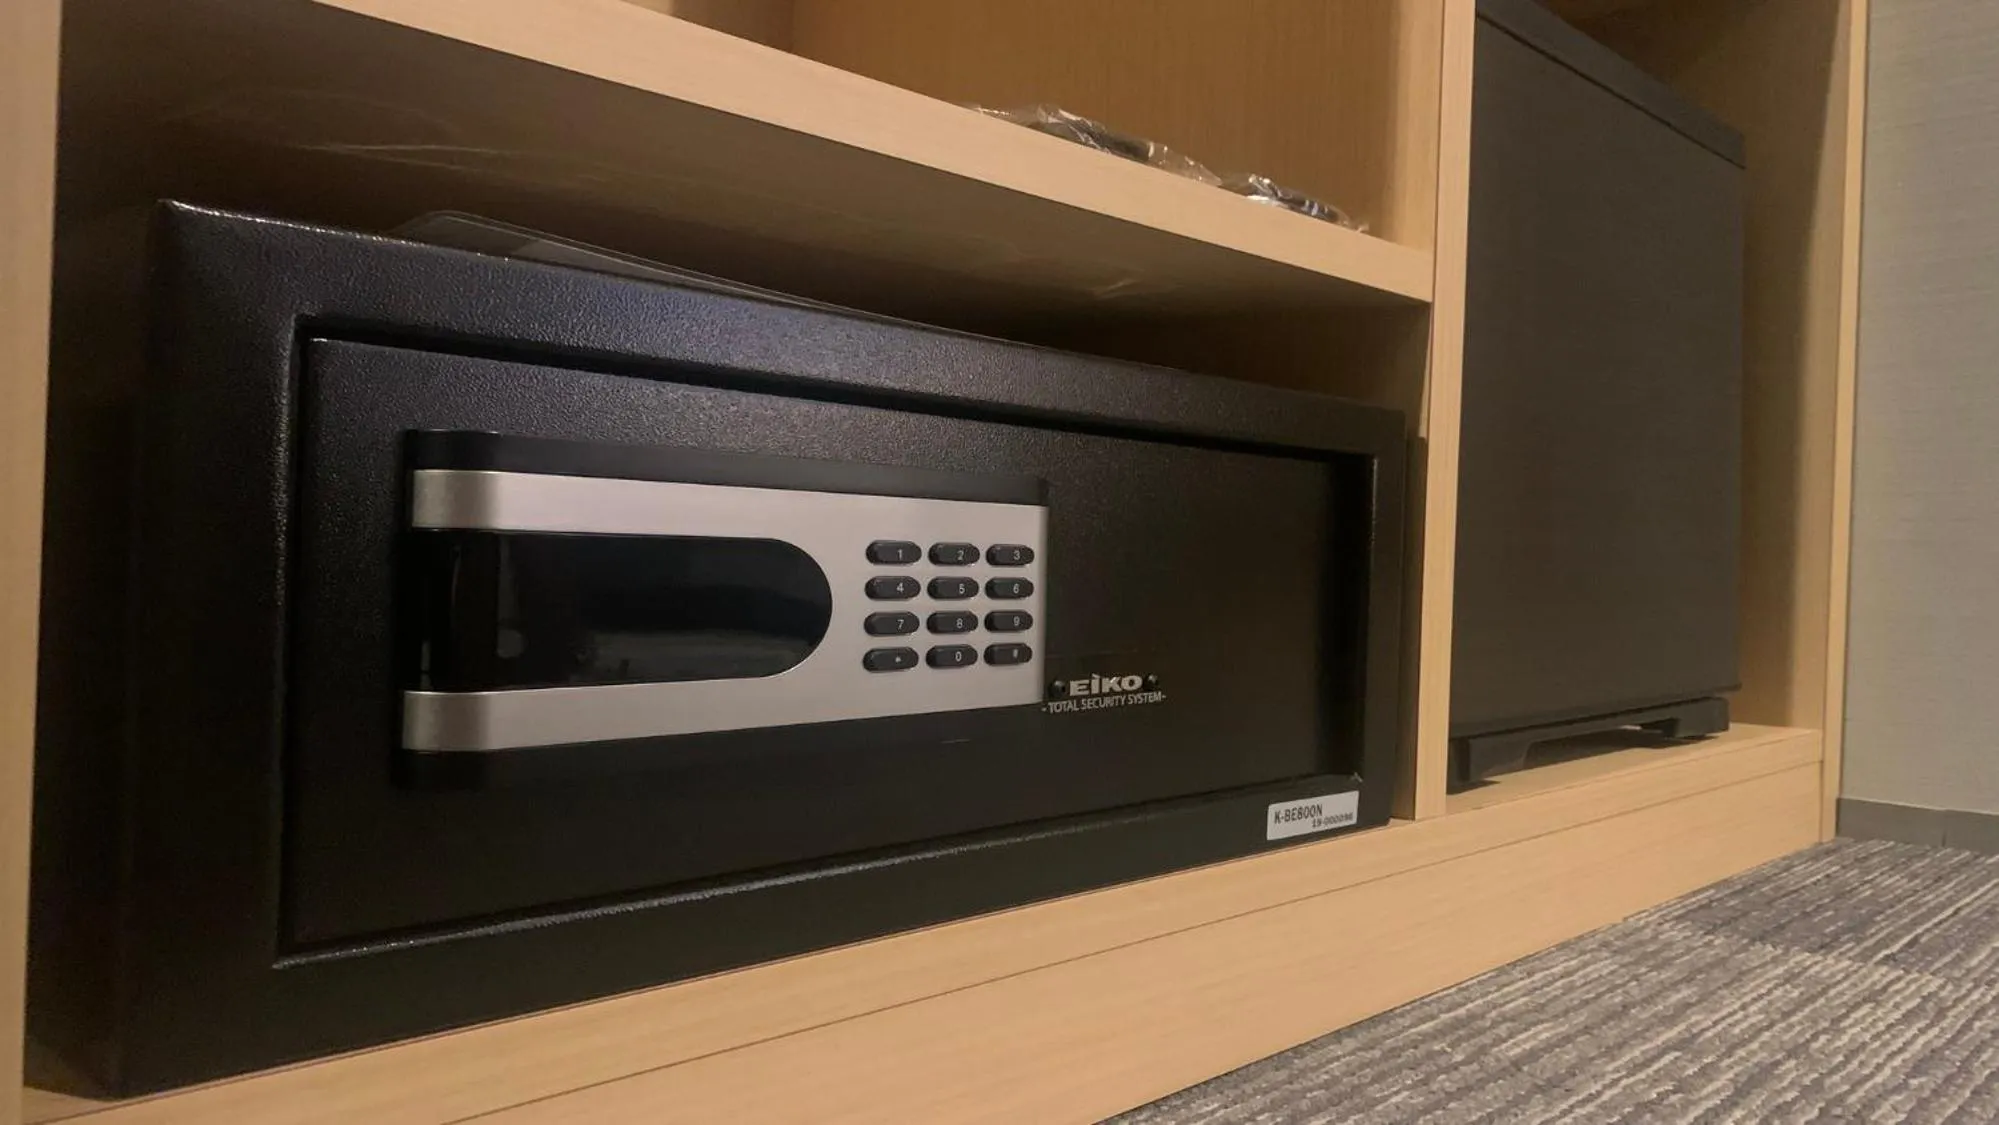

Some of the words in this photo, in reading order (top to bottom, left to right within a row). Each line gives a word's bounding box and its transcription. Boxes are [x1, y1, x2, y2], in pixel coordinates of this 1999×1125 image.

[897, 549, 903, 560] 1
[957, 550, 964, 561] 2
[1013, 550, 1021, 560] 3
[896, 582, 904, 594] 4
[959, 583, 966, 594] 5
[1013, 583, 1020, 594] 6
[897, 619, 904, 630] 7
[956, 618, 963, 629] 8
[1013, 616, 1020, 626] 9
[955, 651, 962, 662] 0
[1081, 694, 1127, 710] SECURITY
